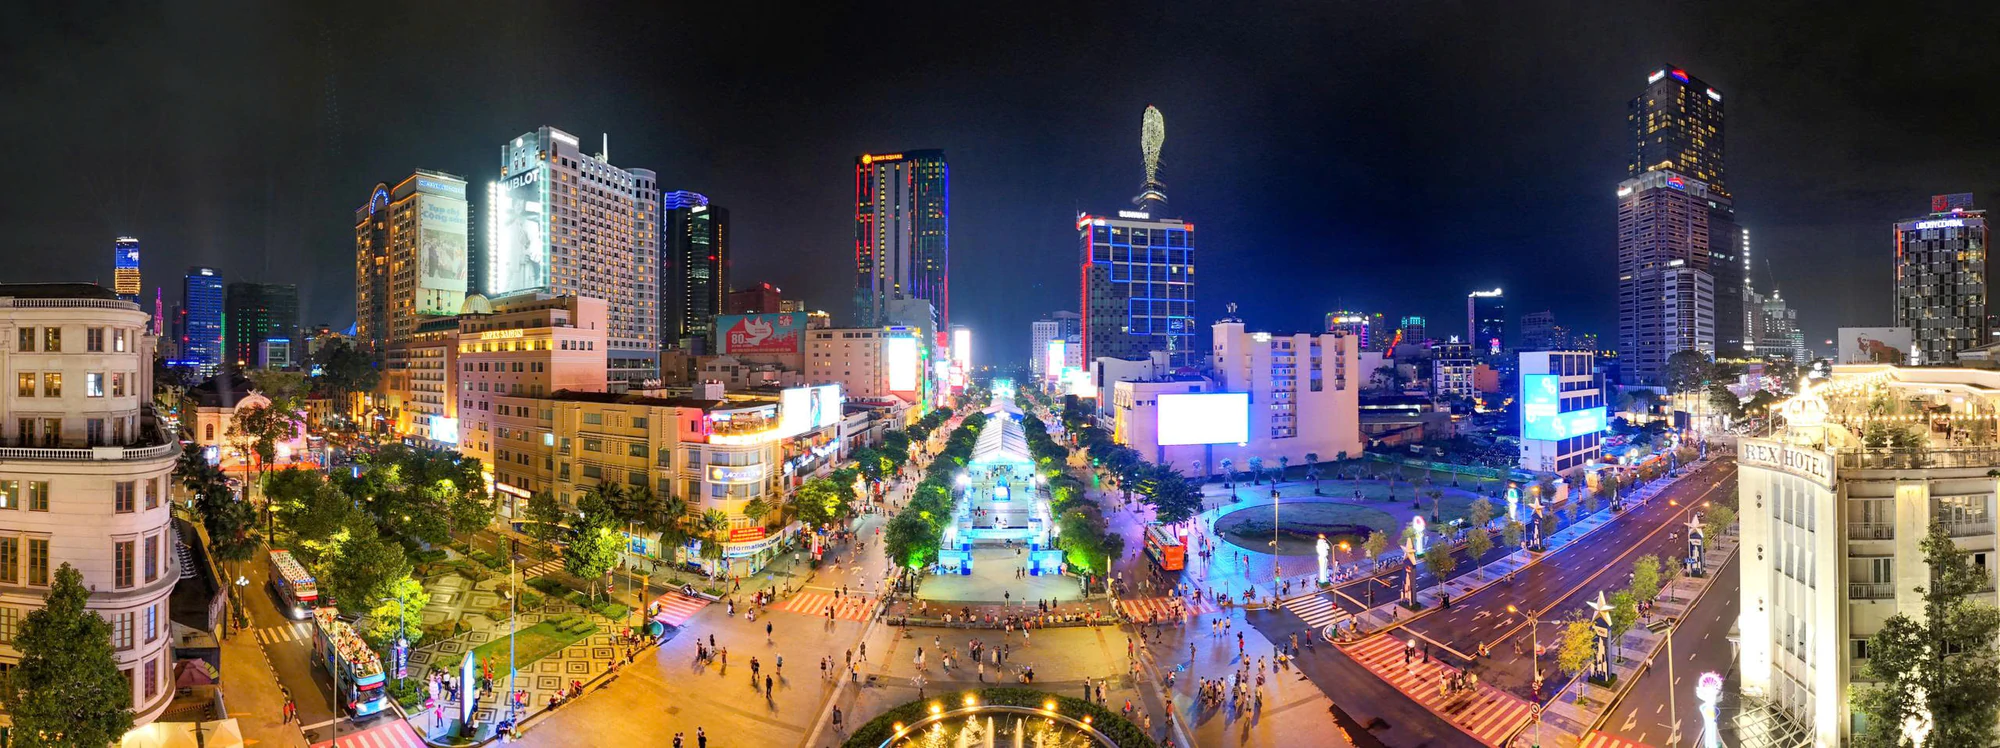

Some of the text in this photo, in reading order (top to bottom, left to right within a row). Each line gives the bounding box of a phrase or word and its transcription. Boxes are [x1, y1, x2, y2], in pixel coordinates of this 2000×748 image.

[1118, 210, 1150, 219] SUNWAH
[731, 333, 744, 344] 80
[1744, 444, 1827, 478] REX HOTEL
